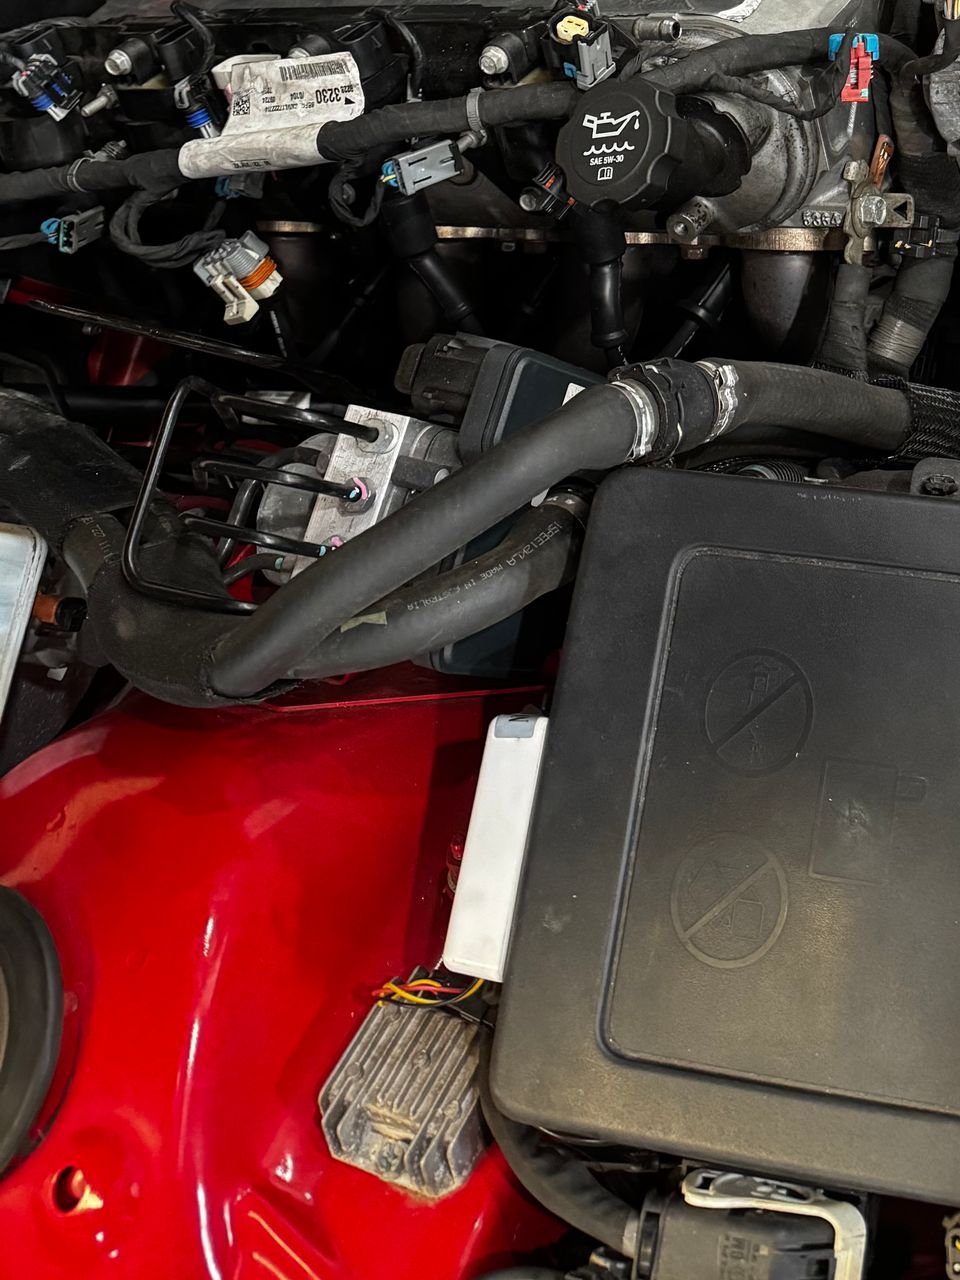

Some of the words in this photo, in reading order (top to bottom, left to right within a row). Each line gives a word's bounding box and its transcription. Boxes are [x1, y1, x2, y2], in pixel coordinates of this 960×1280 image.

[315, 87, 341, 104] 3230
[590, 157, 603, 166] SAE
[603, 154, 625, 164] 5W-30
[480, 564, 503, 581] MADE
